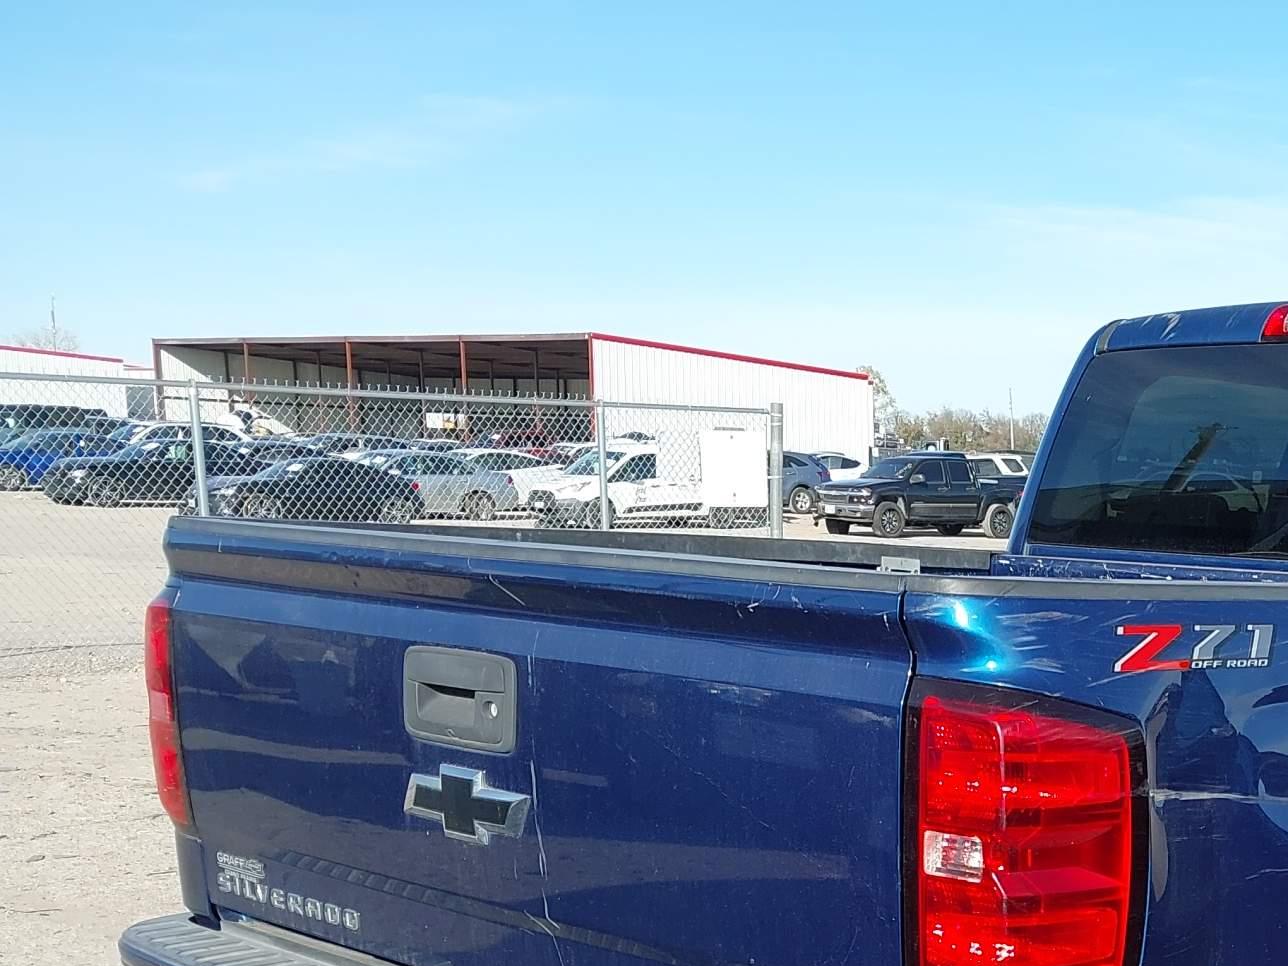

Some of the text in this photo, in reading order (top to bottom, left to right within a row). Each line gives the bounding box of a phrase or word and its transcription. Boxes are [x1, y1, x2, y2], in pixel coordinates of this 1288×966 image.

[1113, 623, 1274, 672] Z71
[1190, 658, 1268, 669] OFF ROAD
[216, 872, 360, 931] SILVERADO
